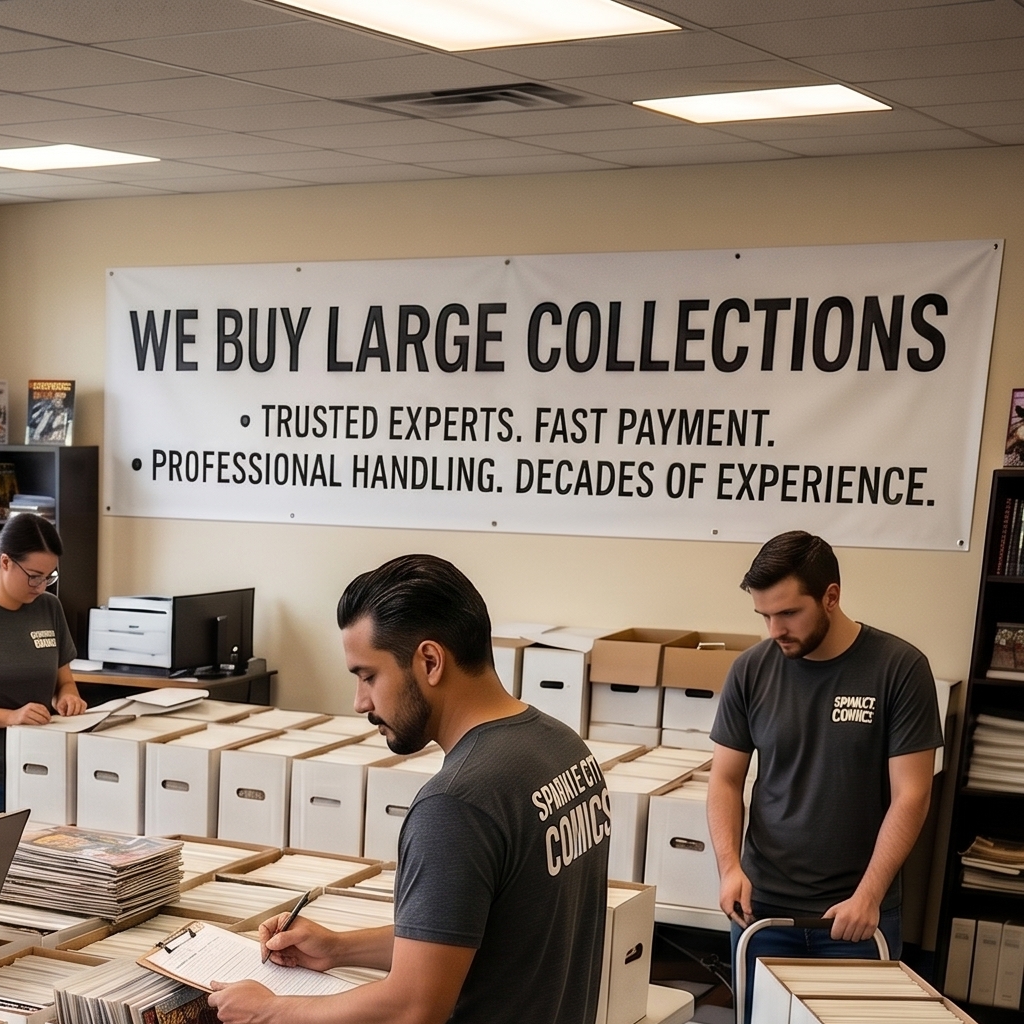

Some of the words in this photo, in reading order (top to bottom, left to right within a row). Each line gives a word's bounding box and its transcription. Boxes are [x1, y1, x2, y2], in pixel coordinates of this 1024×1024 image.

[129, 308, 200, 373] WE
[216, 306, 313, 373] BUY
[326, 302, 508, 374] LARGE
[527, 292, 950, 374] COLLECTIONS
[261, 404, 378, 441] TRUSTED
[389, 406, 523, 444] EXPERTS.
[535, 407, 608, 445] FAST
[617, 408, 776, 448] PAYMENT.
[152, 449, 342, 489] PROFESSIONAL
[352, 454, 504, 494] HANDLING.
[515, 458, 655, 499] DECADES
[666, 462, 707, 499] OF
[716, 463, 935, 508] EXPERIENCE.
[545, 787, 611, 877] COMICS
